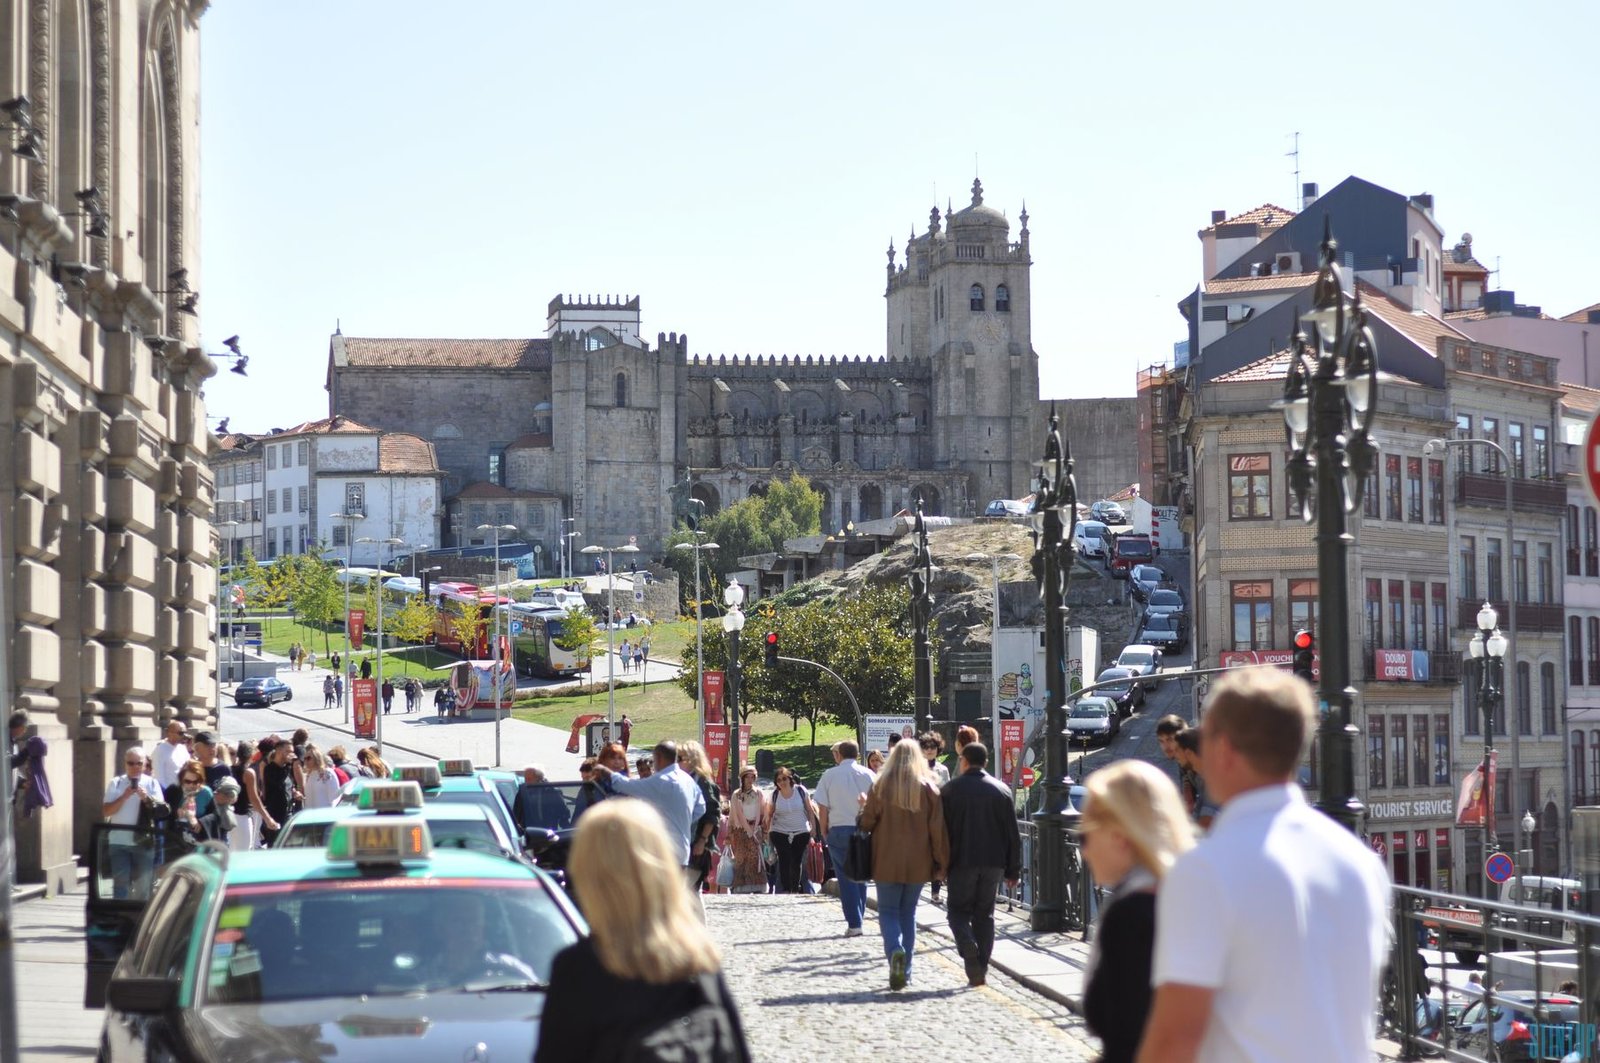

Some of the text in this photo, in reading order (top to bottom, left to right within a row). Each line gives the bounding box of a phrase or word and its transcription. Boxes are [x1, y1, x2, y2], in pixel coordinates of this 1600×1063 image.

[513, 623, 519, 633] P
[1384, 653, 1406, 664] DOURO
[1384, 666, 1407, 677] CRUISES
[374, 787, 399, 801] TAXI
[1368, 799, 1453, 818] TOURIST SERVICE
[355, 826, 395, 850] TAXI
